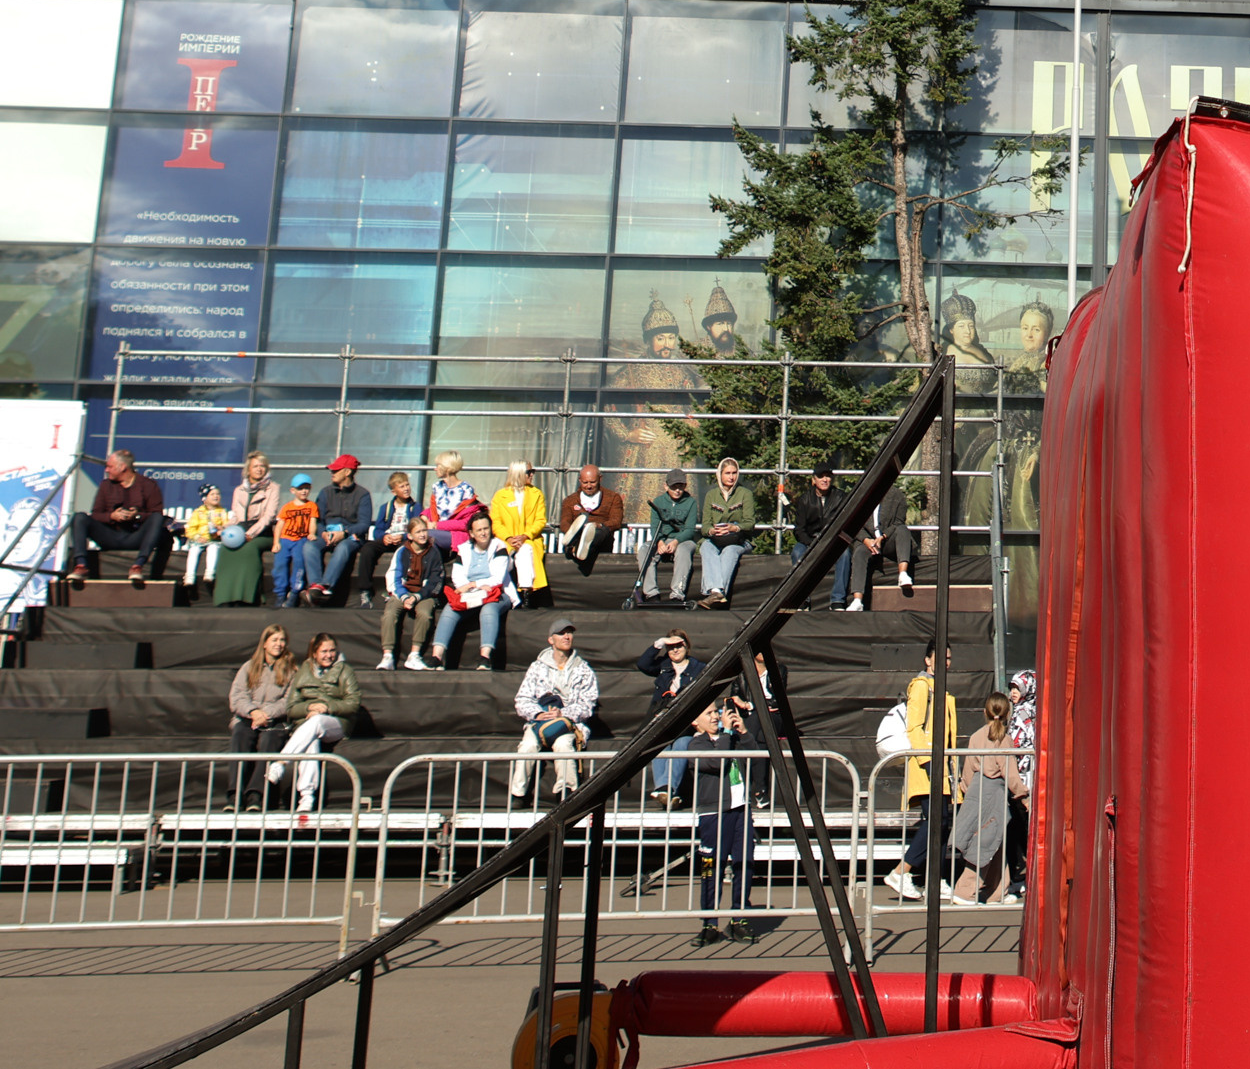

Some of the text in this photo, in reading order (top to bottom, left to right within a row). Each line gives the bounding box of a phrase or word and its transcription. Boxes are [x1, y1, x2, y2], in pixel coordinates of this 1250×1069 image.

[180, 33, 241, 43] РОЖДЕНИЕ
[179, 43, 240, 54] ИМПЕРИИ
[188, 76, 216, 150] ПЕР
[137, 211, 240, 224] «Необходимость
[123, 235, 185, 244] движения
[188, 236, 203, 245] на
[110, 279, 250, 293] обязанности при этом
[206, 306, 245, 316] народ
[102, 326, 247, 339] поднялся и собрался в
[143, 468, 204, 481] Соловьев
